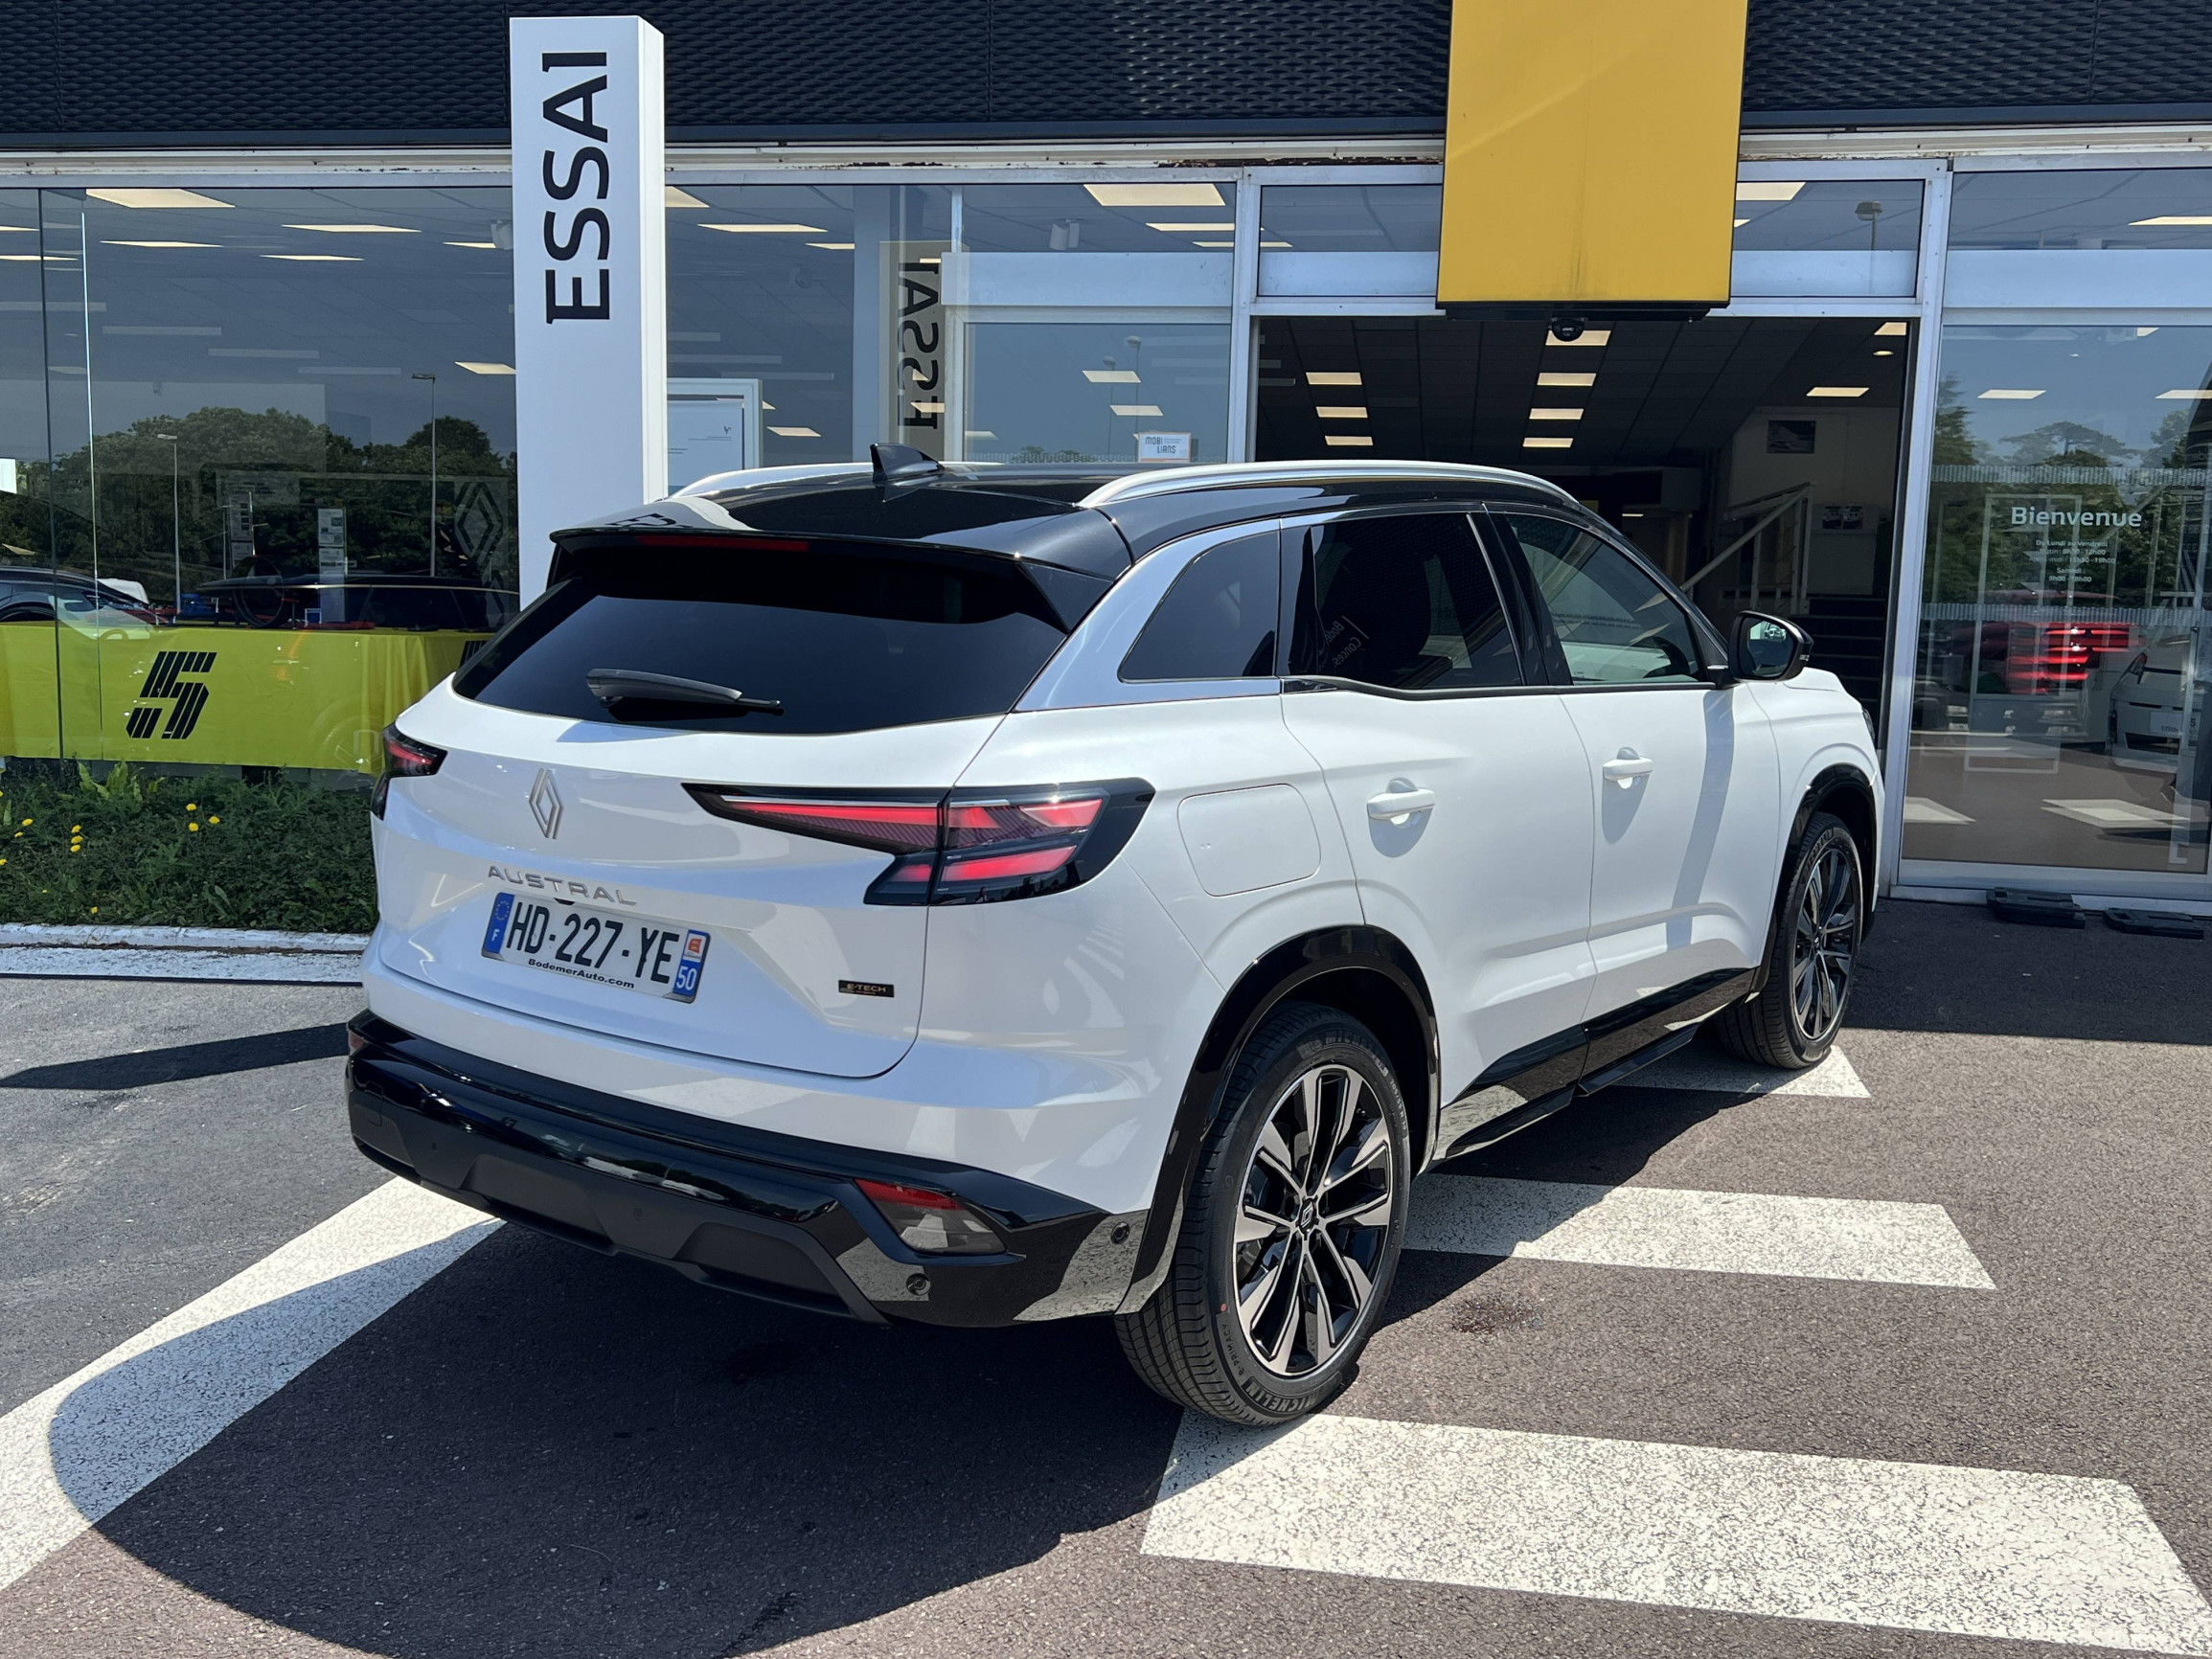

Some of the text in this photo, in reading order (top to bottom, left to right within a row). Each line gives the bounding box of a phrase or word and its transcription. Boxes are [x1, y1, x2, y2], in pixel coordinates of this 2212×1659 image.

[542, 52, 610, 325] ESSAI
[2011, 506, 2142, 527] Bienvenue
[488, 865, 637, 906] AUSTRAL
[490, 928, 500, 942] F
[506, 901, 680, 985] HD-227-YE
[528, 958, 635, 989] BodemerAuto.com
[675, 965, 697, 991] 50
[1244, 1380, 1319, 1413] MICHELIN
